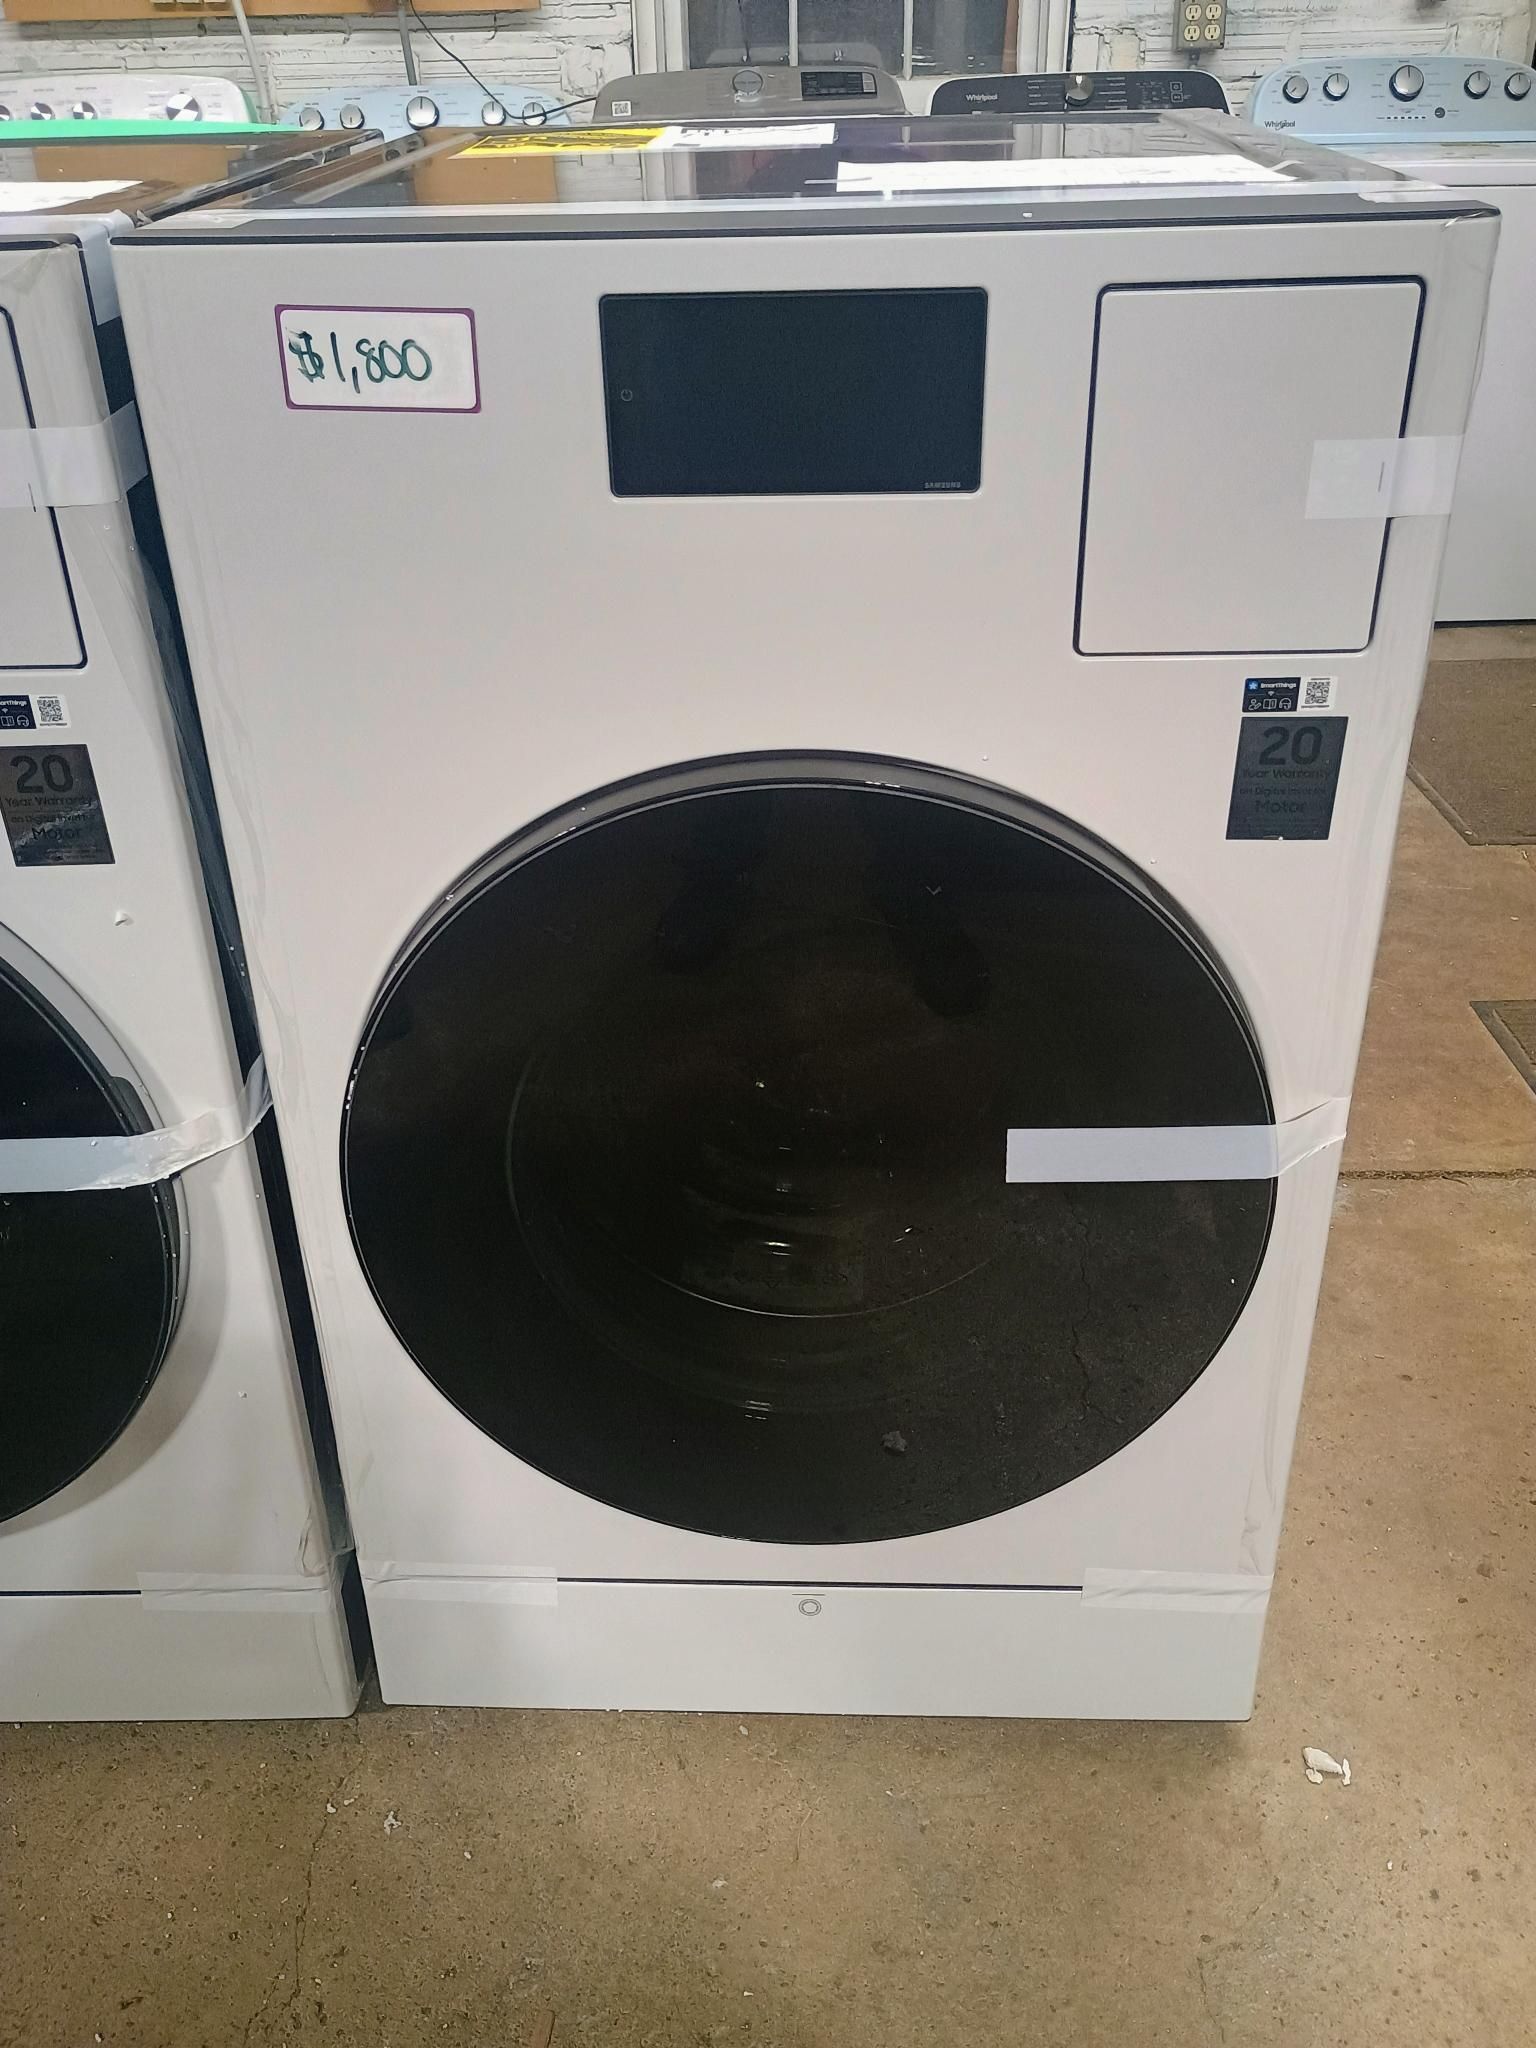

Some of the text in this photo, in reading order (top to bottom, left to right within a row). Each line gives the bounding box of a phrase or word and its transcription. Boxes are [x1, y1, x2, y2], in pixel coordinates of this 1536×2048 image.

[965, 94, 998, 102] Whirlpool
[1264, 120, 1296, 131] Whirlpool
[286, 329, 432, 394] $1,800
[1258, 726, 1323, 765] 20
[9, 754, 74, 793] 20
[1243, 768, 1329, 780] Year Warranty
[5, 795, 93, 808] Year Warranty
[1255, 800, 1307, 813] Motor
[31, 827, 83, 841] Motor
